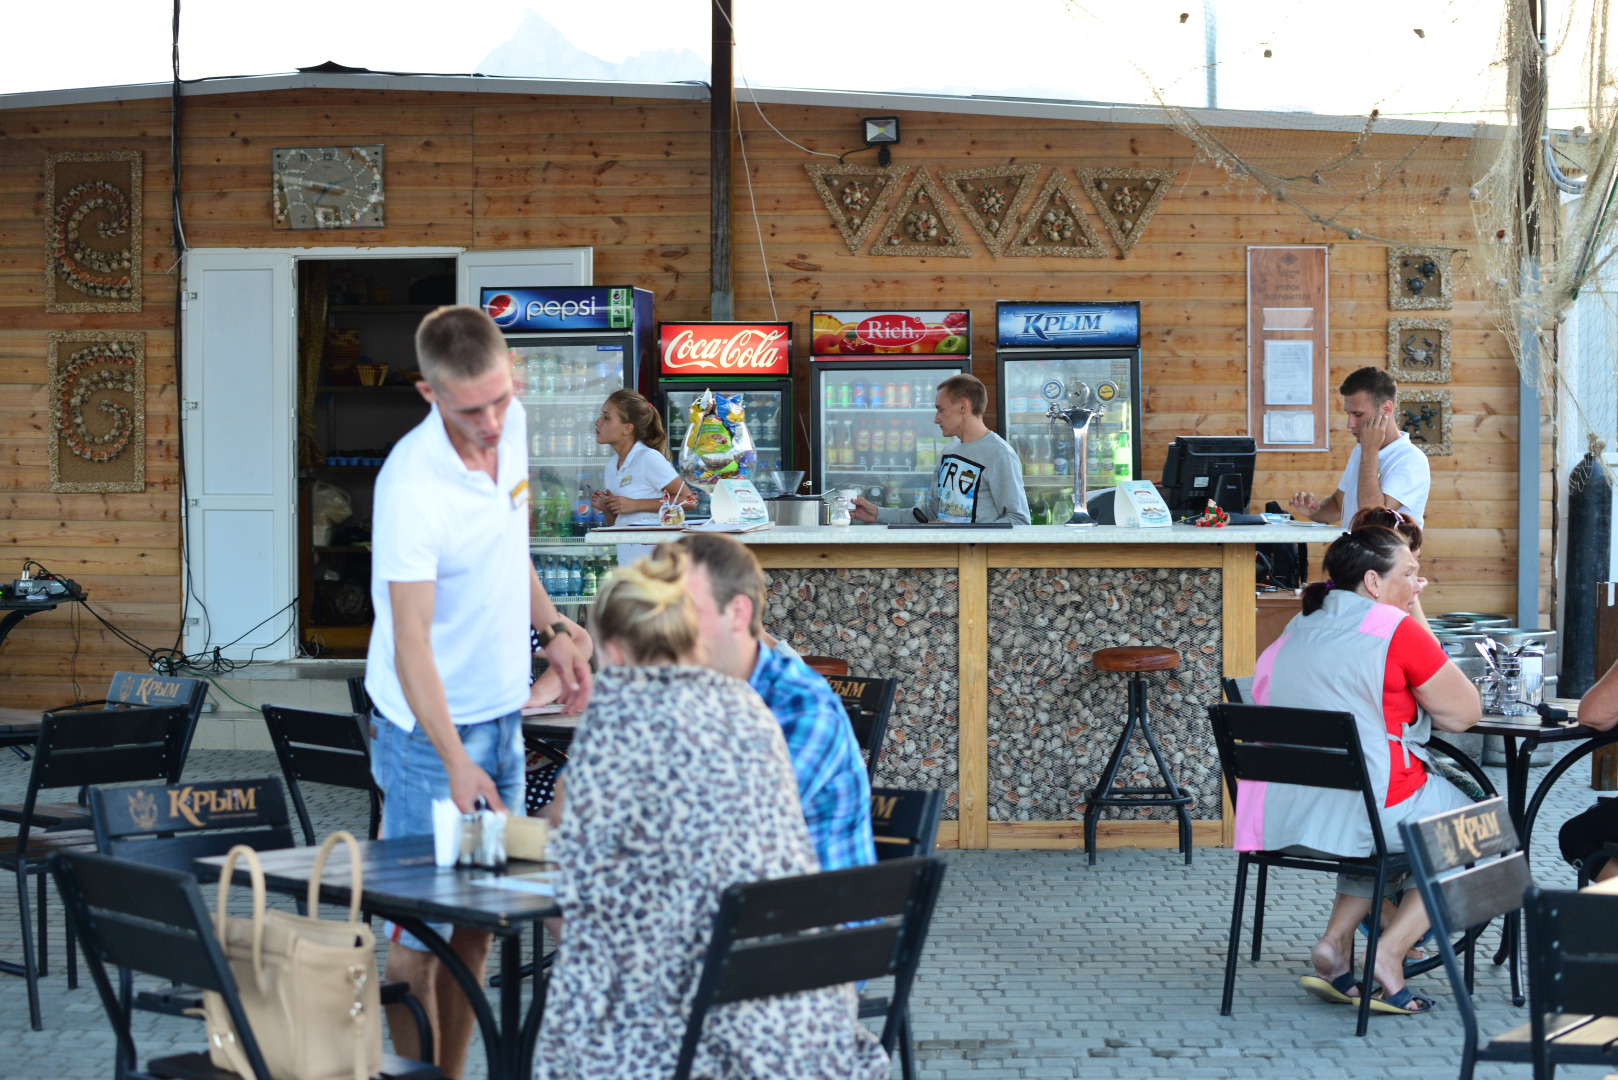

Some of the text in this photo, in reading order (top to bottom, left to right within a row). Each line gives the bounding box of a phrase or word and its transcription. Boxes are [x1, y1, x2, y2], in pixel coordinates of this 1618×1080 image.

[526, 296, 596, 321] pepsi
[663, 329, 787, 369] Coca-Cola
[825, 675, 867, 698] РЫМ
